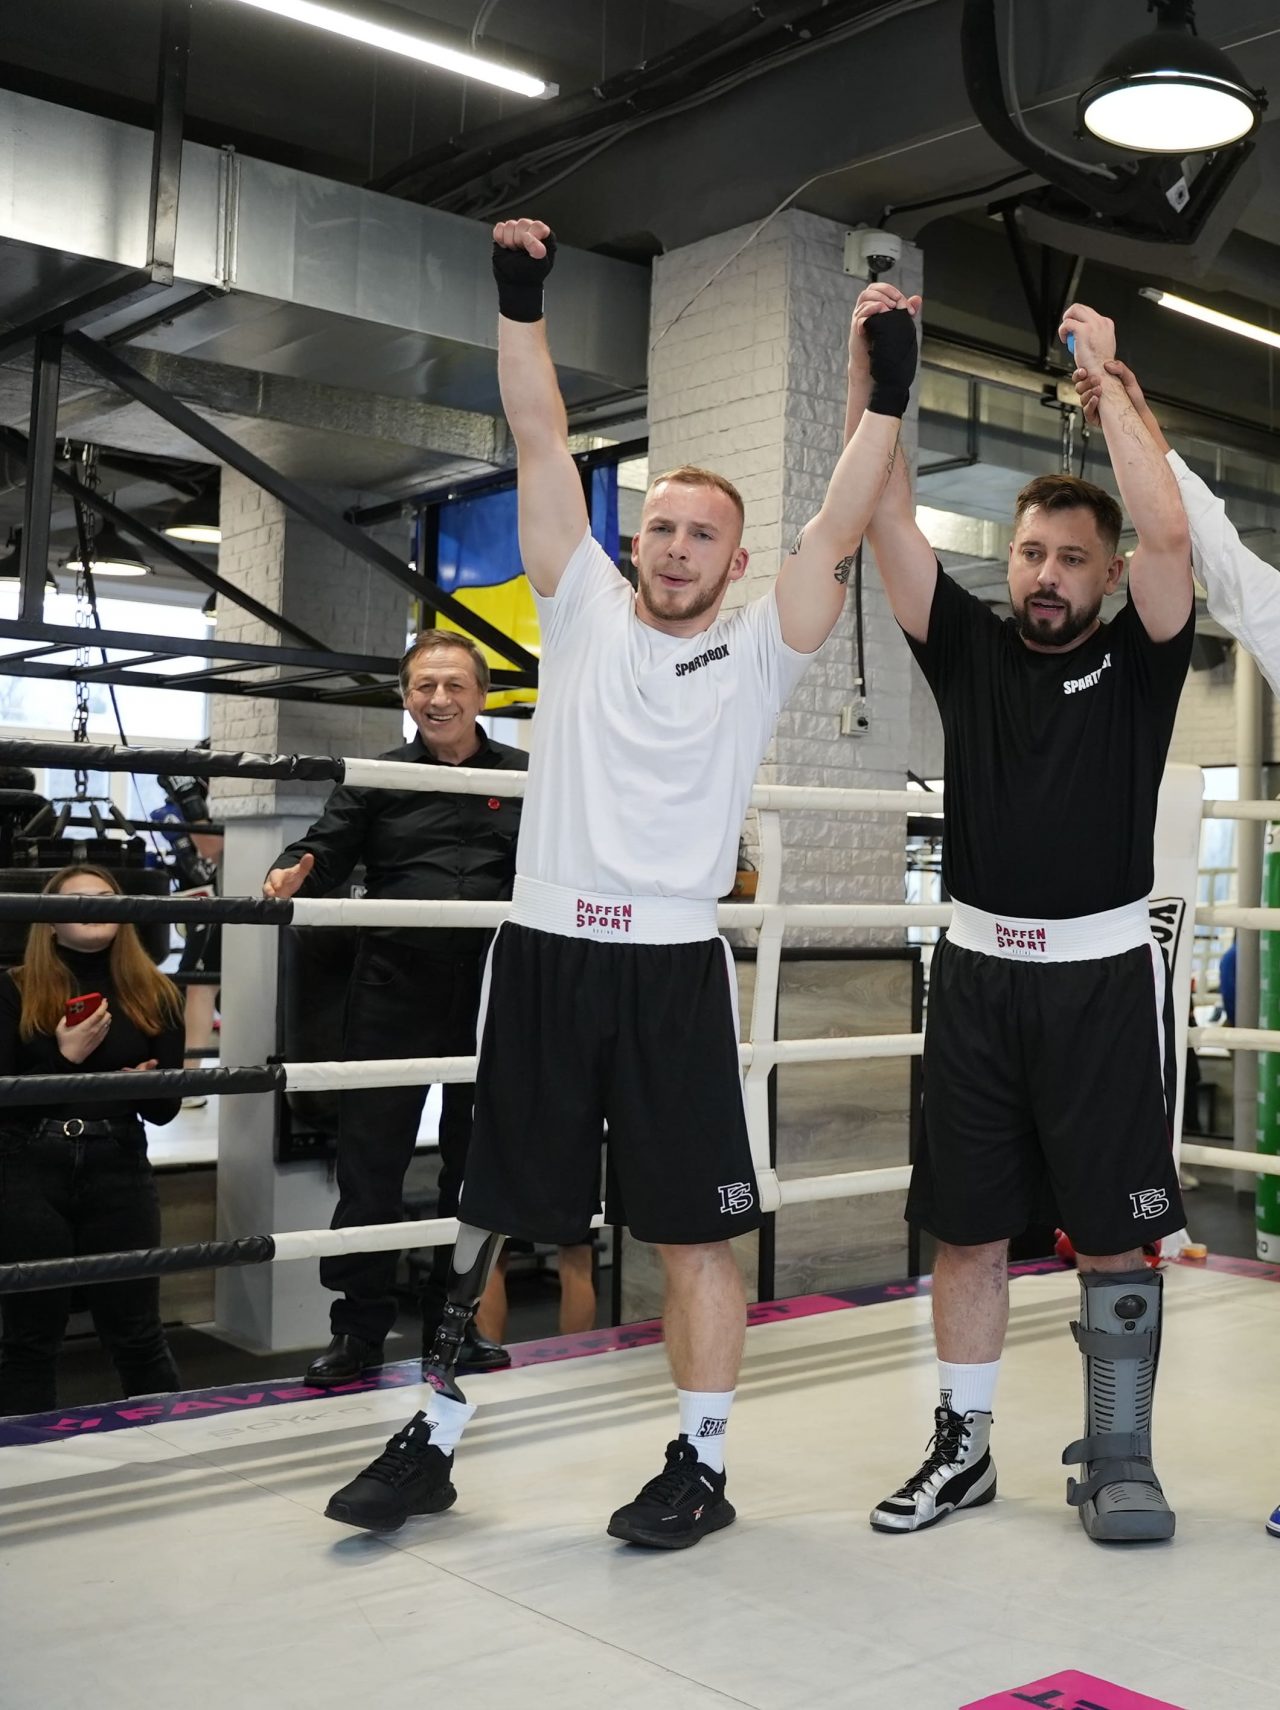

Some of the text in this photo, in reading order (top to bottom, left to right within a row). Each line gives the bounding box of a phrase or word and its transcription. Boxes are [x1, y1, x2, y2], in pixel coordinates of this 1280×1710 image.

[577, 898, 632, 918] PAFFEN
[576, 914, 632, 932] SPORT
[995, 922, 1046, 940] PAFFEN
[997, 936, 1047, 953] SPORT
